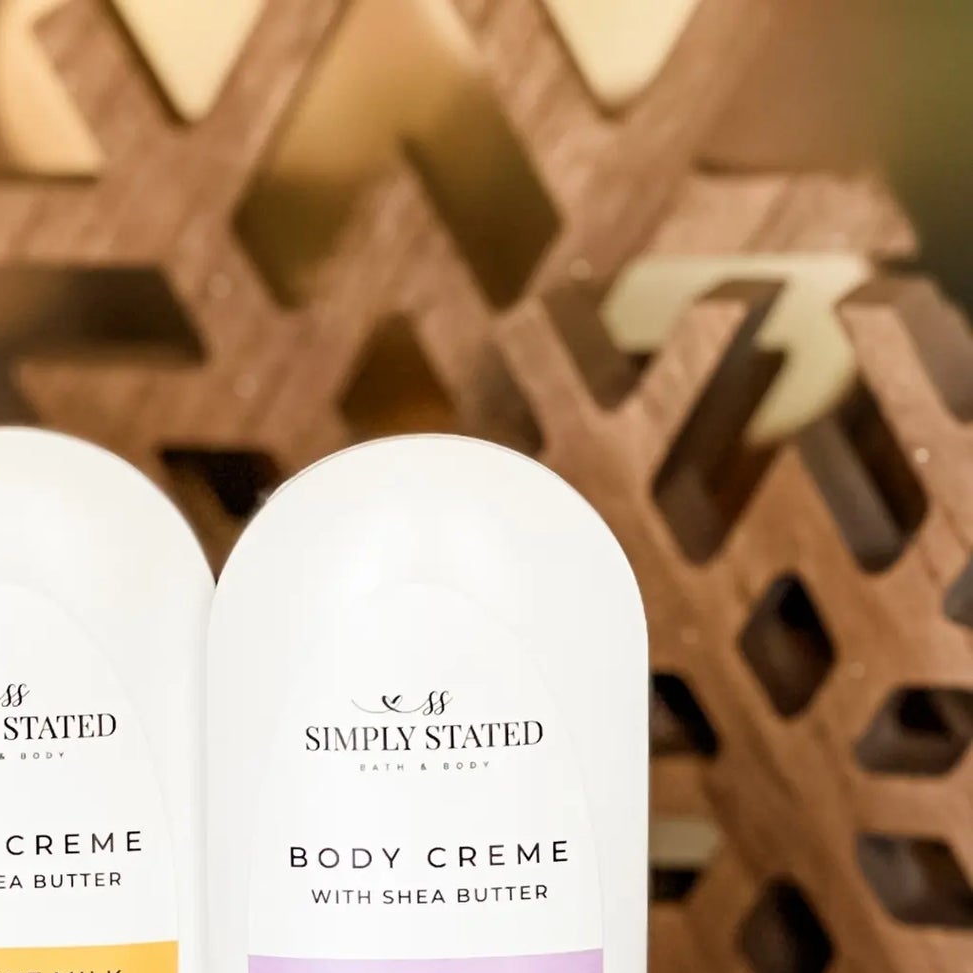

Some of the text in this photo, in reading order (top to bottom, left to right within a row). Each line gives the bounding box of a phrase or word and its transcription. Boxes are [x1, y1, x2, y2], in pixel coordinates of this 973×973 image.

[4, 713, 117, 740] STATED
[305, 720, 543, 751] SIMPLY STATED
[20, 751, 64, 760] BODY
[360, 761, 489, 771] BATH & BODY
[6, 831, 141, 855] CREME
[290, 840, 568, 868] BODY CREME
[34, 872, 121, 889] BUTTER
[311, 884, 548, 904] WITH SHEA BUTTER
